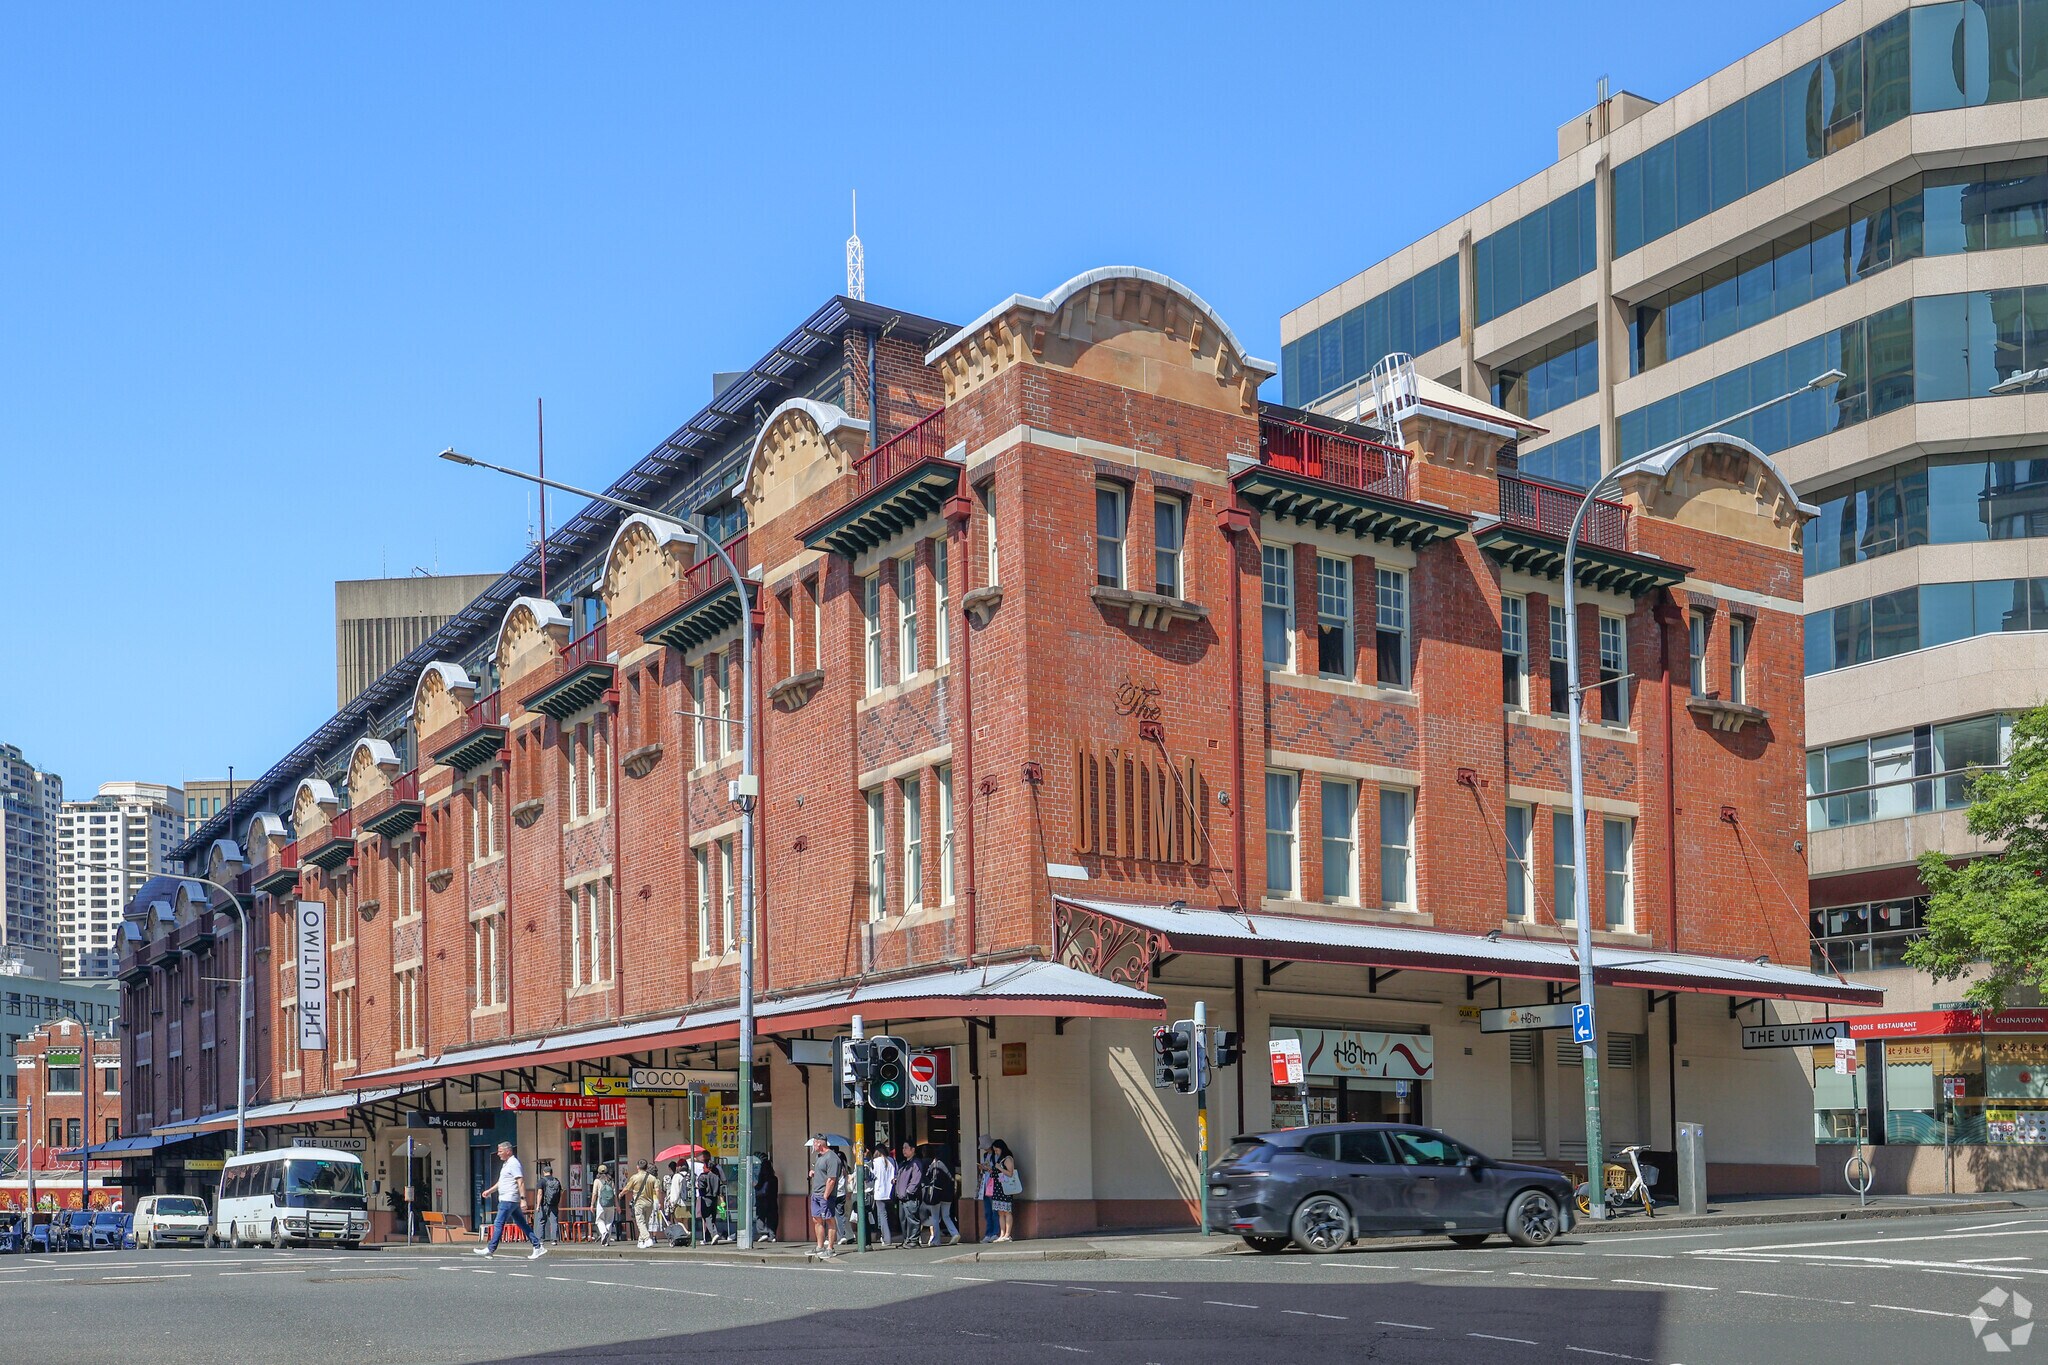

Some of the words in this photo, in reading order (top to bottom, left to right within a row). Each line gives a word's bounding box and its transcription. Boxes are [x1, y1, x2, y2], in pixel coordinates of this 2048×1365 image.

[1072, 738, 1202, 866] ULTIMO
[303, 910, 321, 990] ULTIMO
[305, 1001, 321, 1038] THE
[1576, 1008, 1584, 1023] P
[1877, 1021, 1917, 1031] RESTAURANT
[1750, 1030, 1775, 1043] THE
[1781, 1026, 1838, 1042] ULTIMO
[633, 1070, 686, 1087] COCO
[915, 1084, 929, 1093] NO
[558, 1097, 583, 1107] THAI
[910, 1093, 934, 1101] ENTRY
[600, 1103, 619, 1121] THAI
[442, 1119, 477, 1127] Karaoke
[298, 1139, 317, 1148] THE
[321, 1139, 361, 1148] ULTIMO
